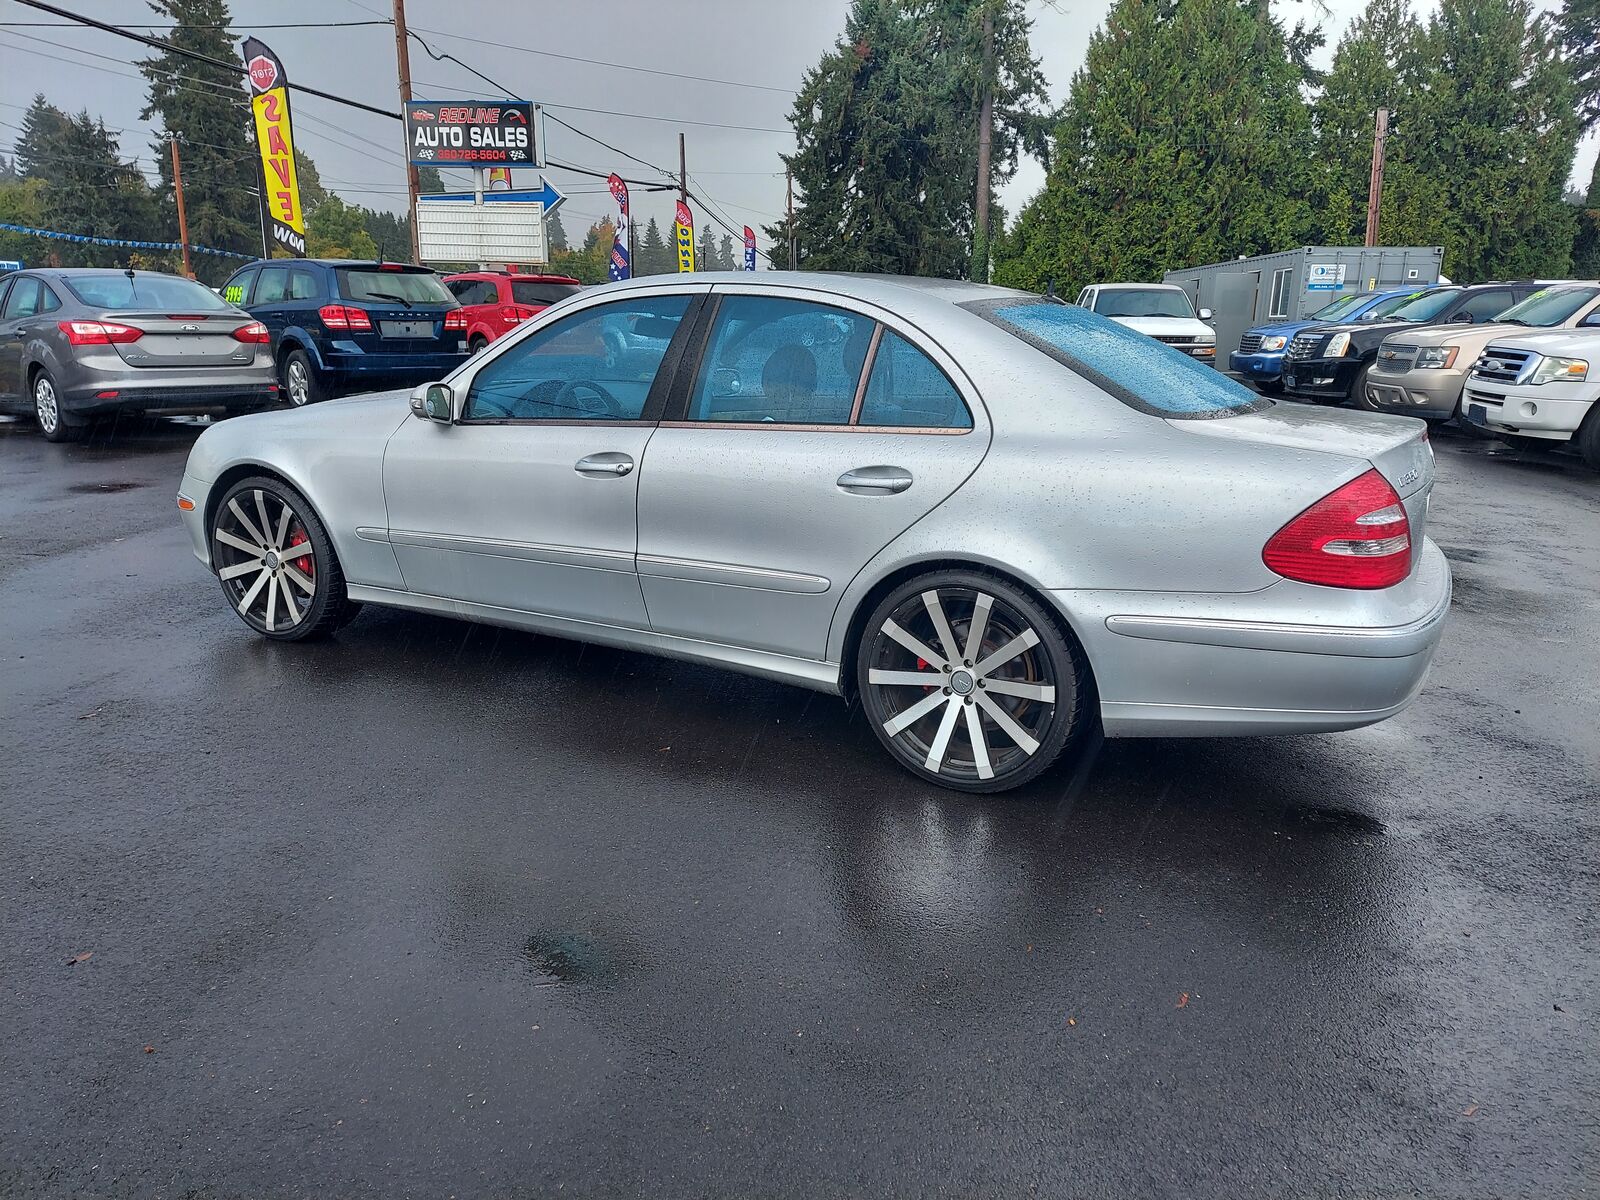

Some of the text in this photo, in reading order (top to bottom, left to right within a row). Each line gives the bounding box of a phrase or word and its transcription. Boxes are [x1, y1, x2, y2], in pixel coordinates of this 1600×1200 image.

[438, 107, 500, 124] REDLINE
[415, 126, 528, 147] AUTO SALES
